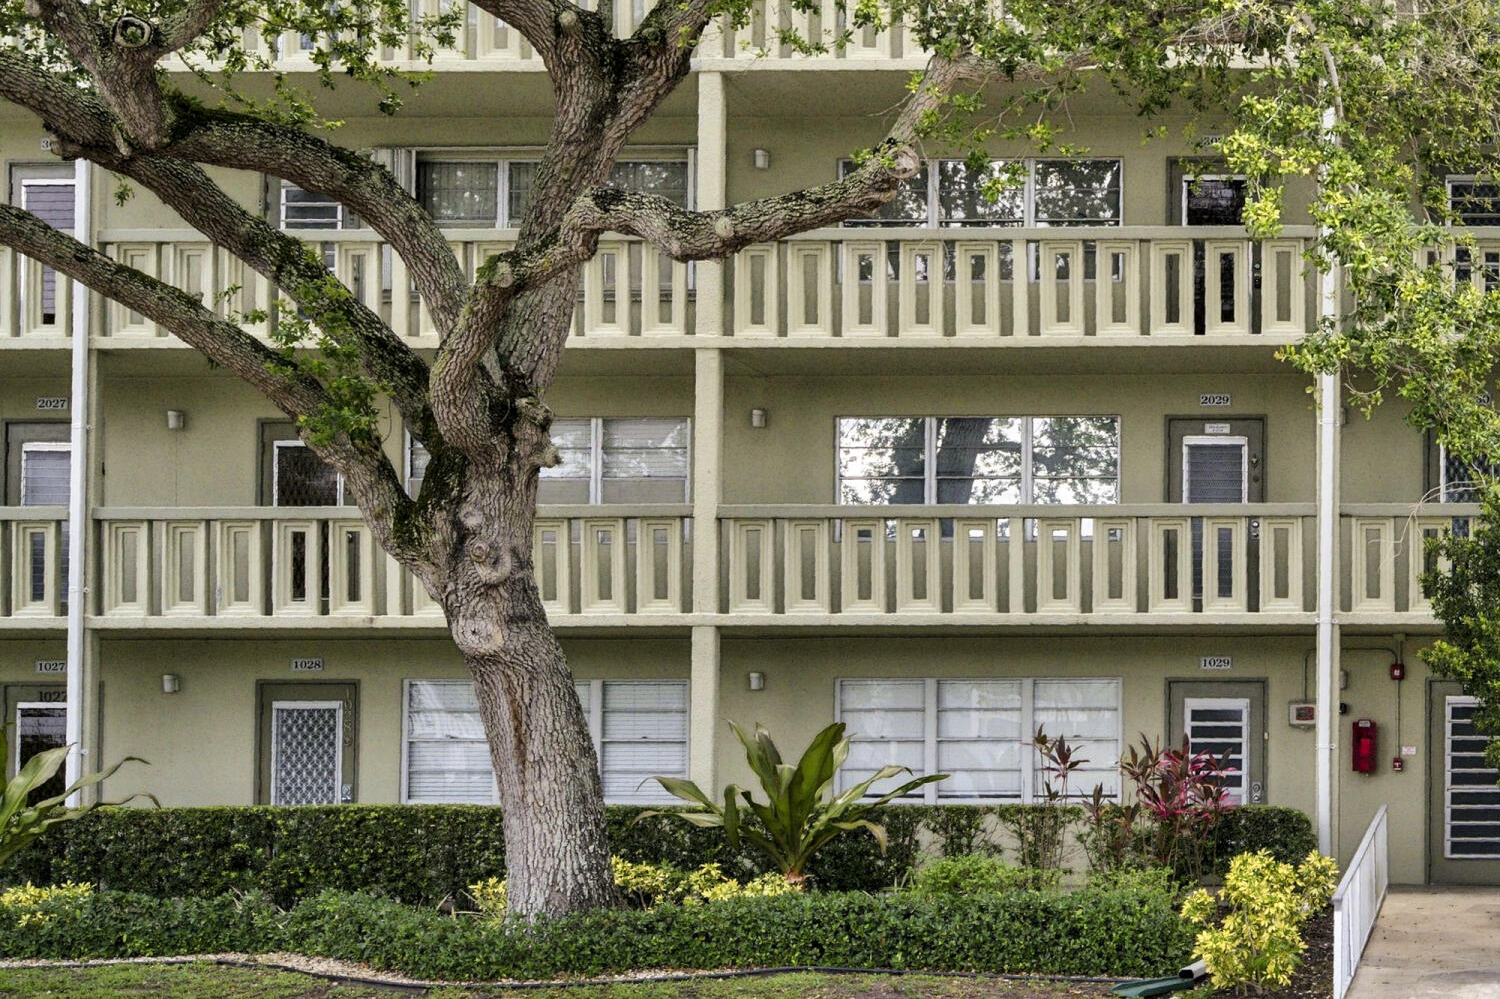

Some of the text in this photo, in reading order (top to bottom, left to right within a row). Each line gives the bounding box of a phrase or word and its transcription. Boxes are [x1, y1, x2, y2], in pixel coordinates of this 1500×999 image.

[38, 399, 66, 408] 2027
[1201, 395, 1230, 405] 2029
[39, 662, 65, 671] 1027
[294, 660, 322, 670] 1028
[1203, 657, 1230, 667] 1029
